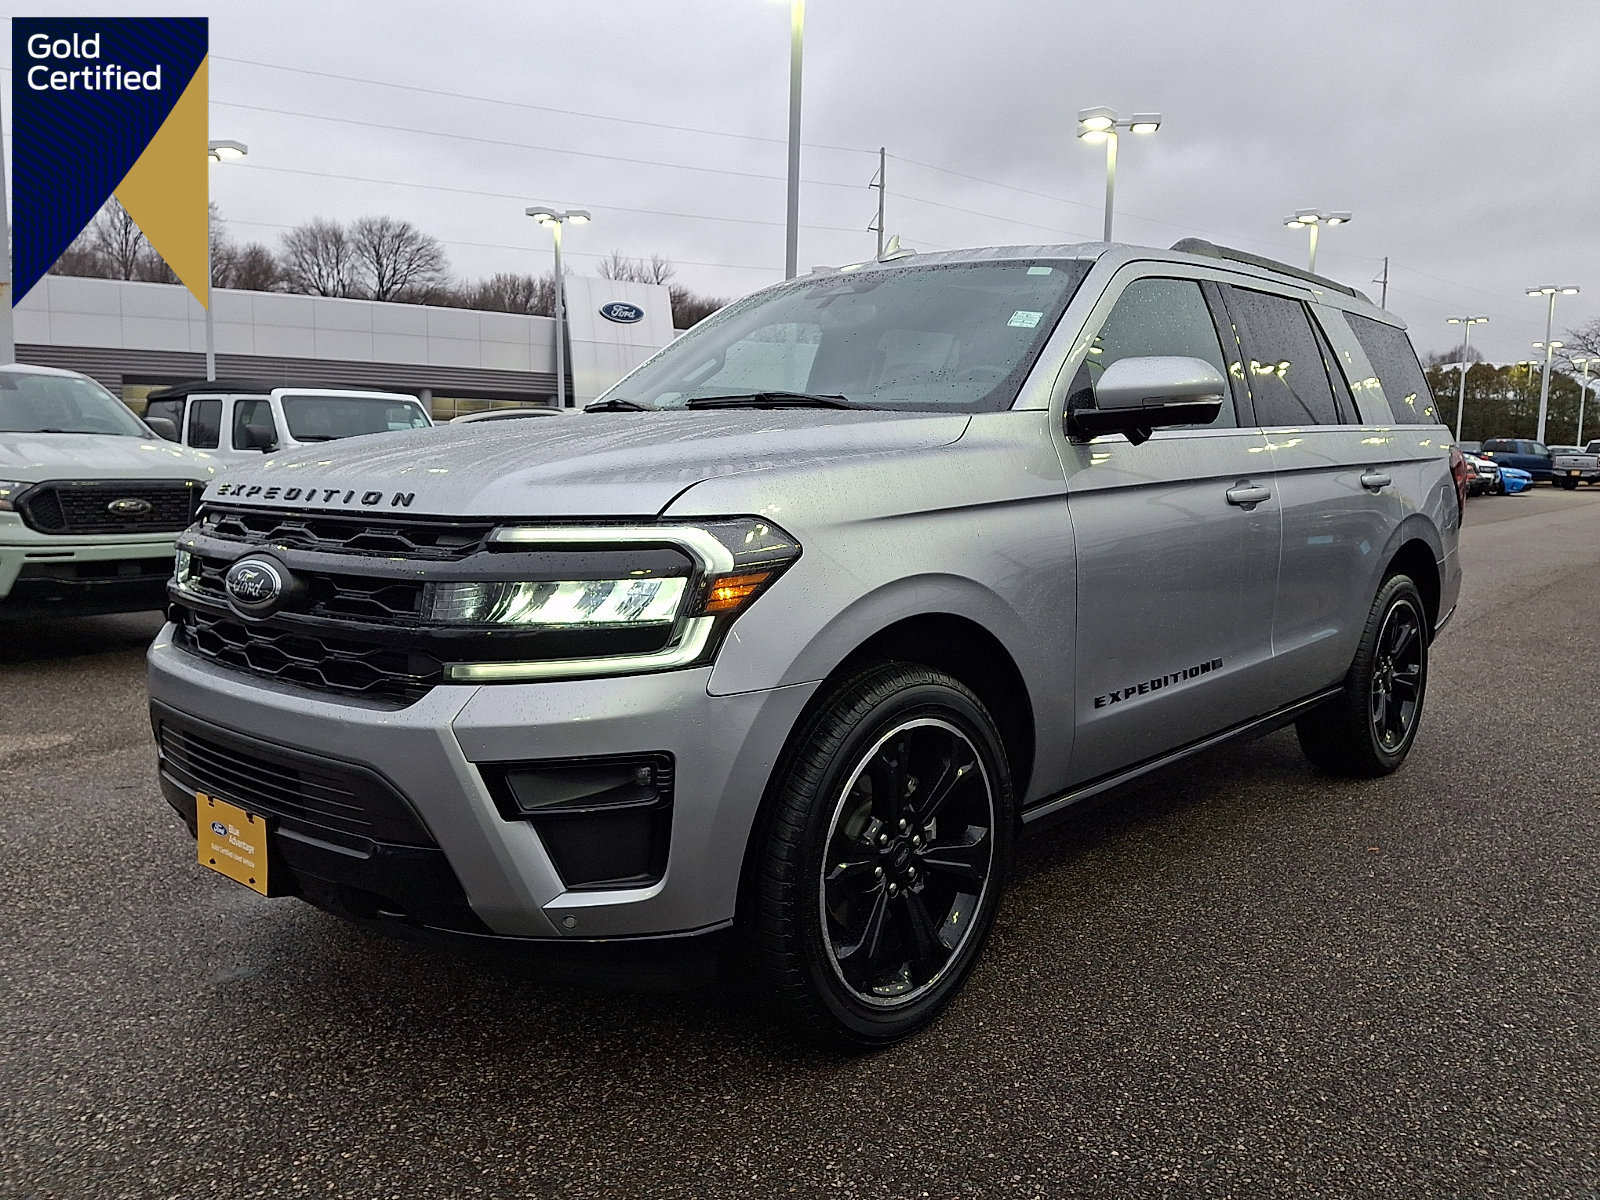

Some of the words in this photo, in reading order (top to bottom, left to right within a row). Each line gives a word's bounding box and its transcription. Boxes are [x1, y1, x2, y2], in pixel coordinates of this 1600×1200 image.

[610, 304, 636, 318] Ford
[217, 483, 416, 507] EXPEDITION
[233, 568, 263, 597] Ford
[1094, 660, 1211, 709] EXPEDITION
